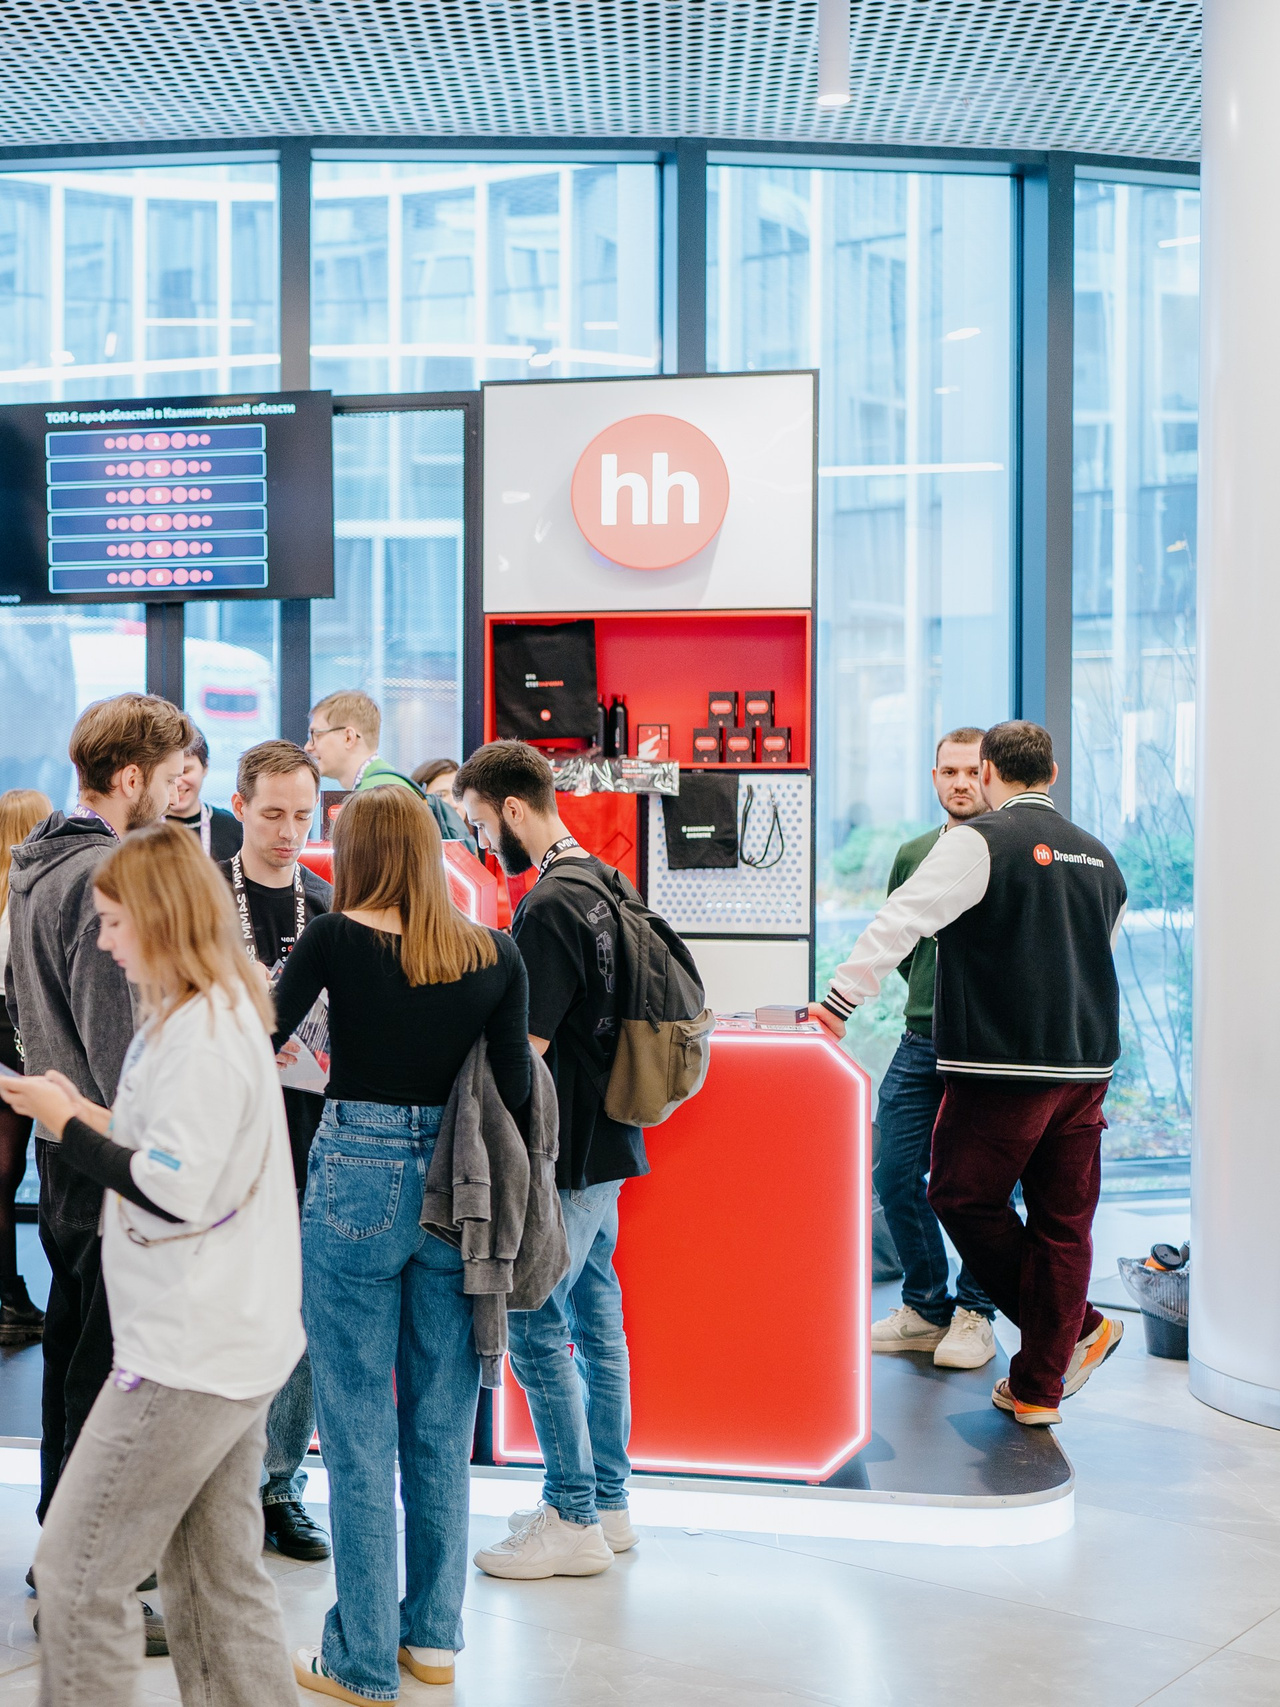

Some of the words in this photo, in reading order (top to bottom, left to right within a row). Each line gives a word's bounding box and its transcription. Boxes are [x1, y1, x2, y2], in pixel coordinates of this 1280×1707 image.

[45, 411, 78, 424] ТОП-6
[79, 407, 154, 424] профобластей
[155, 409, 162, 419] в
[163, 402, 251, 419] Калининградской
[251, 403, 296, 415] области
[153, 437, 160, 447] 1
[154, 463, 161, 473] 2
[601, 452, 700, 526] hh
[155, 517, 163, 527] 4
[156, 572, 163, 582] 6
[1036, 848, 1050, 860] hh
[1053, 850, 1104, 868] DreamTeam
[237, 893, 253, 939] MMAS
